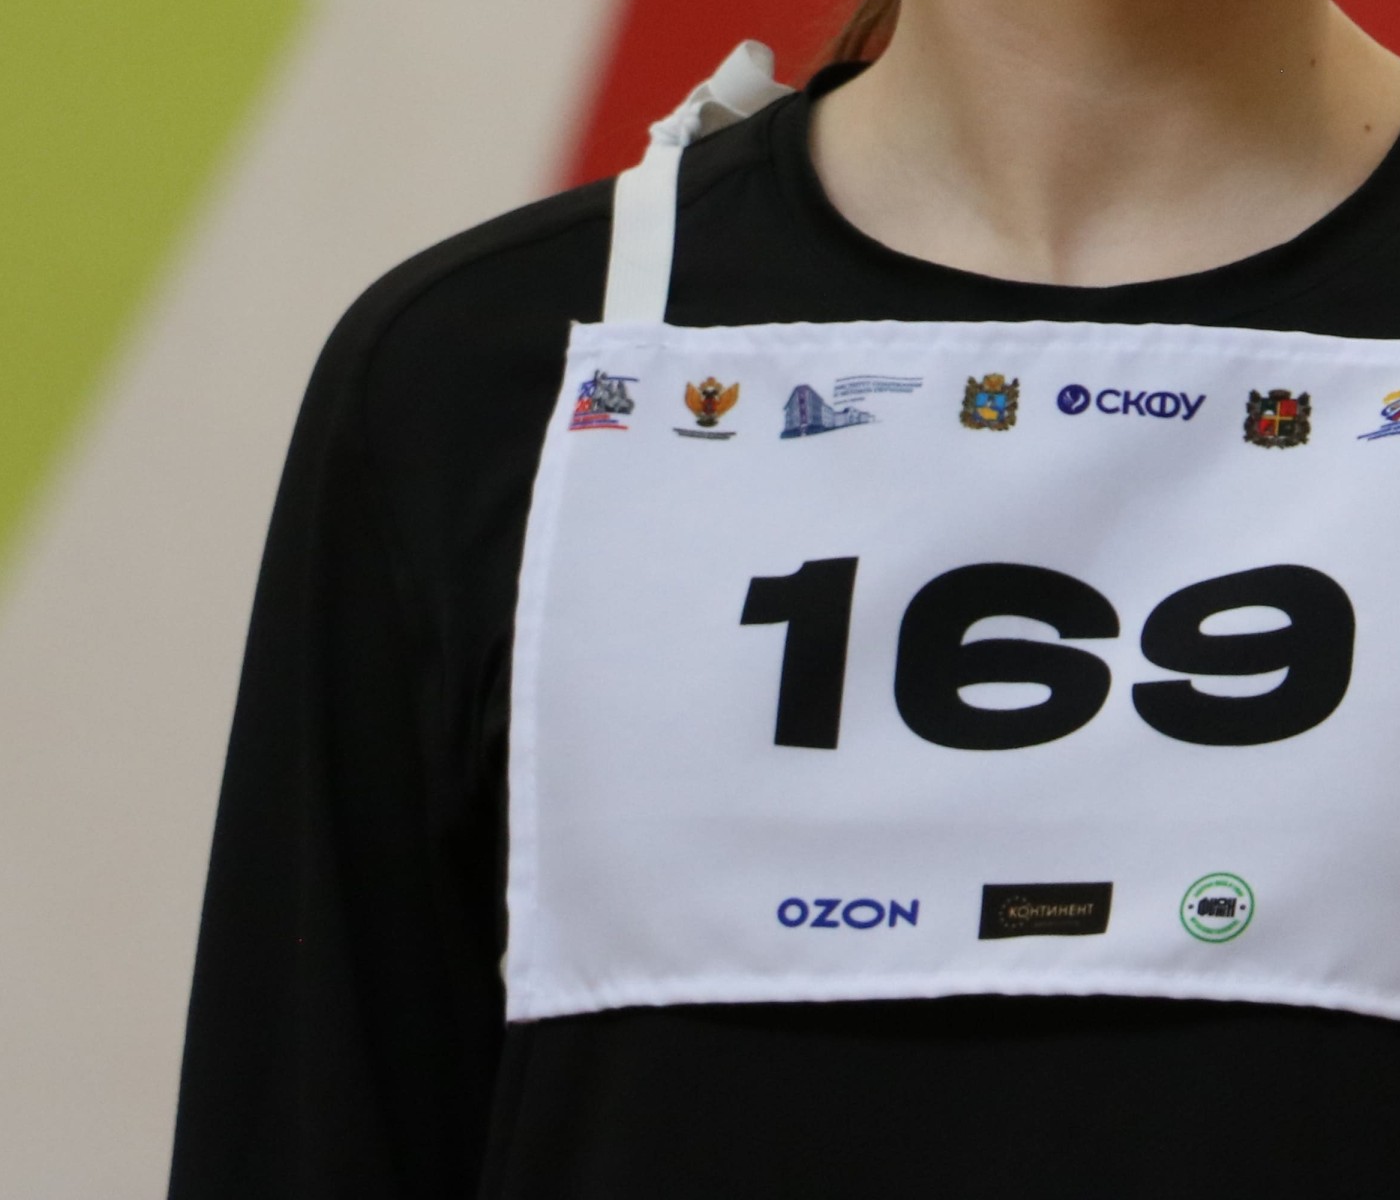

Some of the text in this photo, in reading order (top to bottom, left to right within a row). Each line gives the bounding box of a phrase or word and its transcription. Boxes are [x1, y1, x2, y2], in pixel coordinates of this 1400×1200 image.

[1095, 388, 1207, 422] СКФУ
[739, 556, 1356, 751] 169
[776, 897, 920, 930] OZON
[1008, 903, 1094, 918] КОНТИНЕНТ
